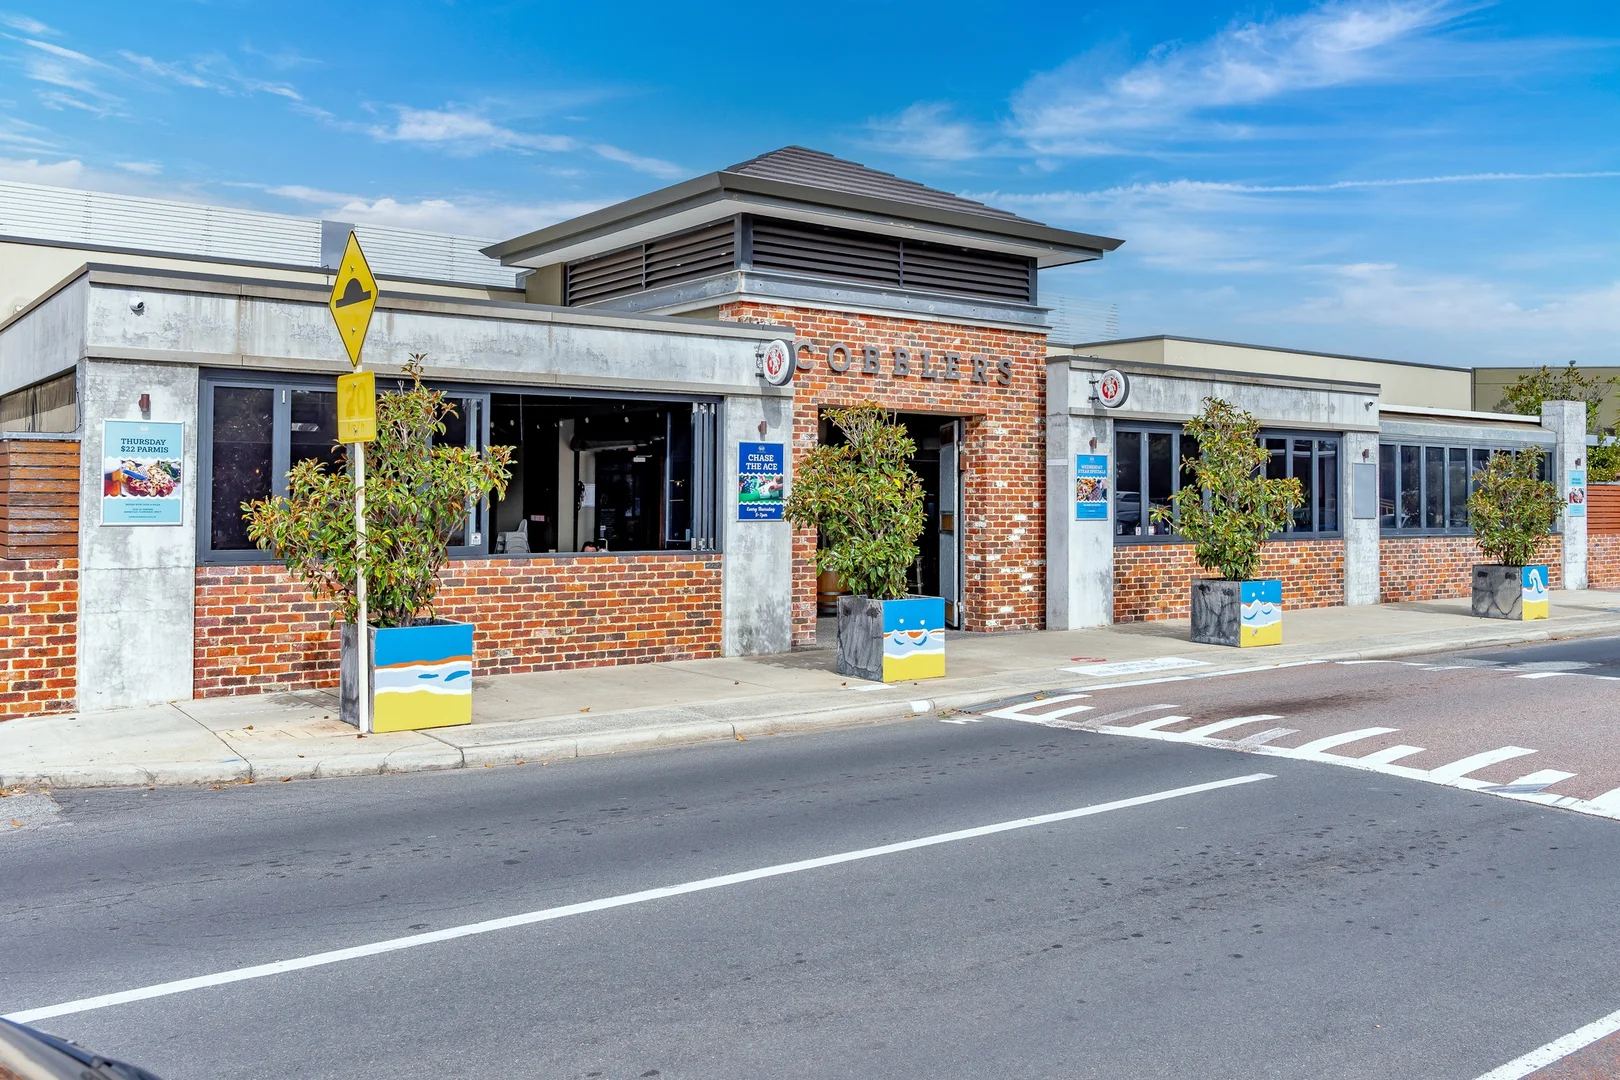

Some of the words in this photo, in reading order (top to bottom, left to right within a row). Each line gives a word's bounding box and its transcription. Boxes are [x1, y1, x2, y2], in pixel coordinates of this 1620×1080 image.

[794, 340, 1013, 386] COBBLERS
[346, 382, 367, 418] 20
[120, 438, 167, 446] THURSDAY
[137, 446, 169, 454] PARMIS
[748, 454, 774, 462] CHASE
